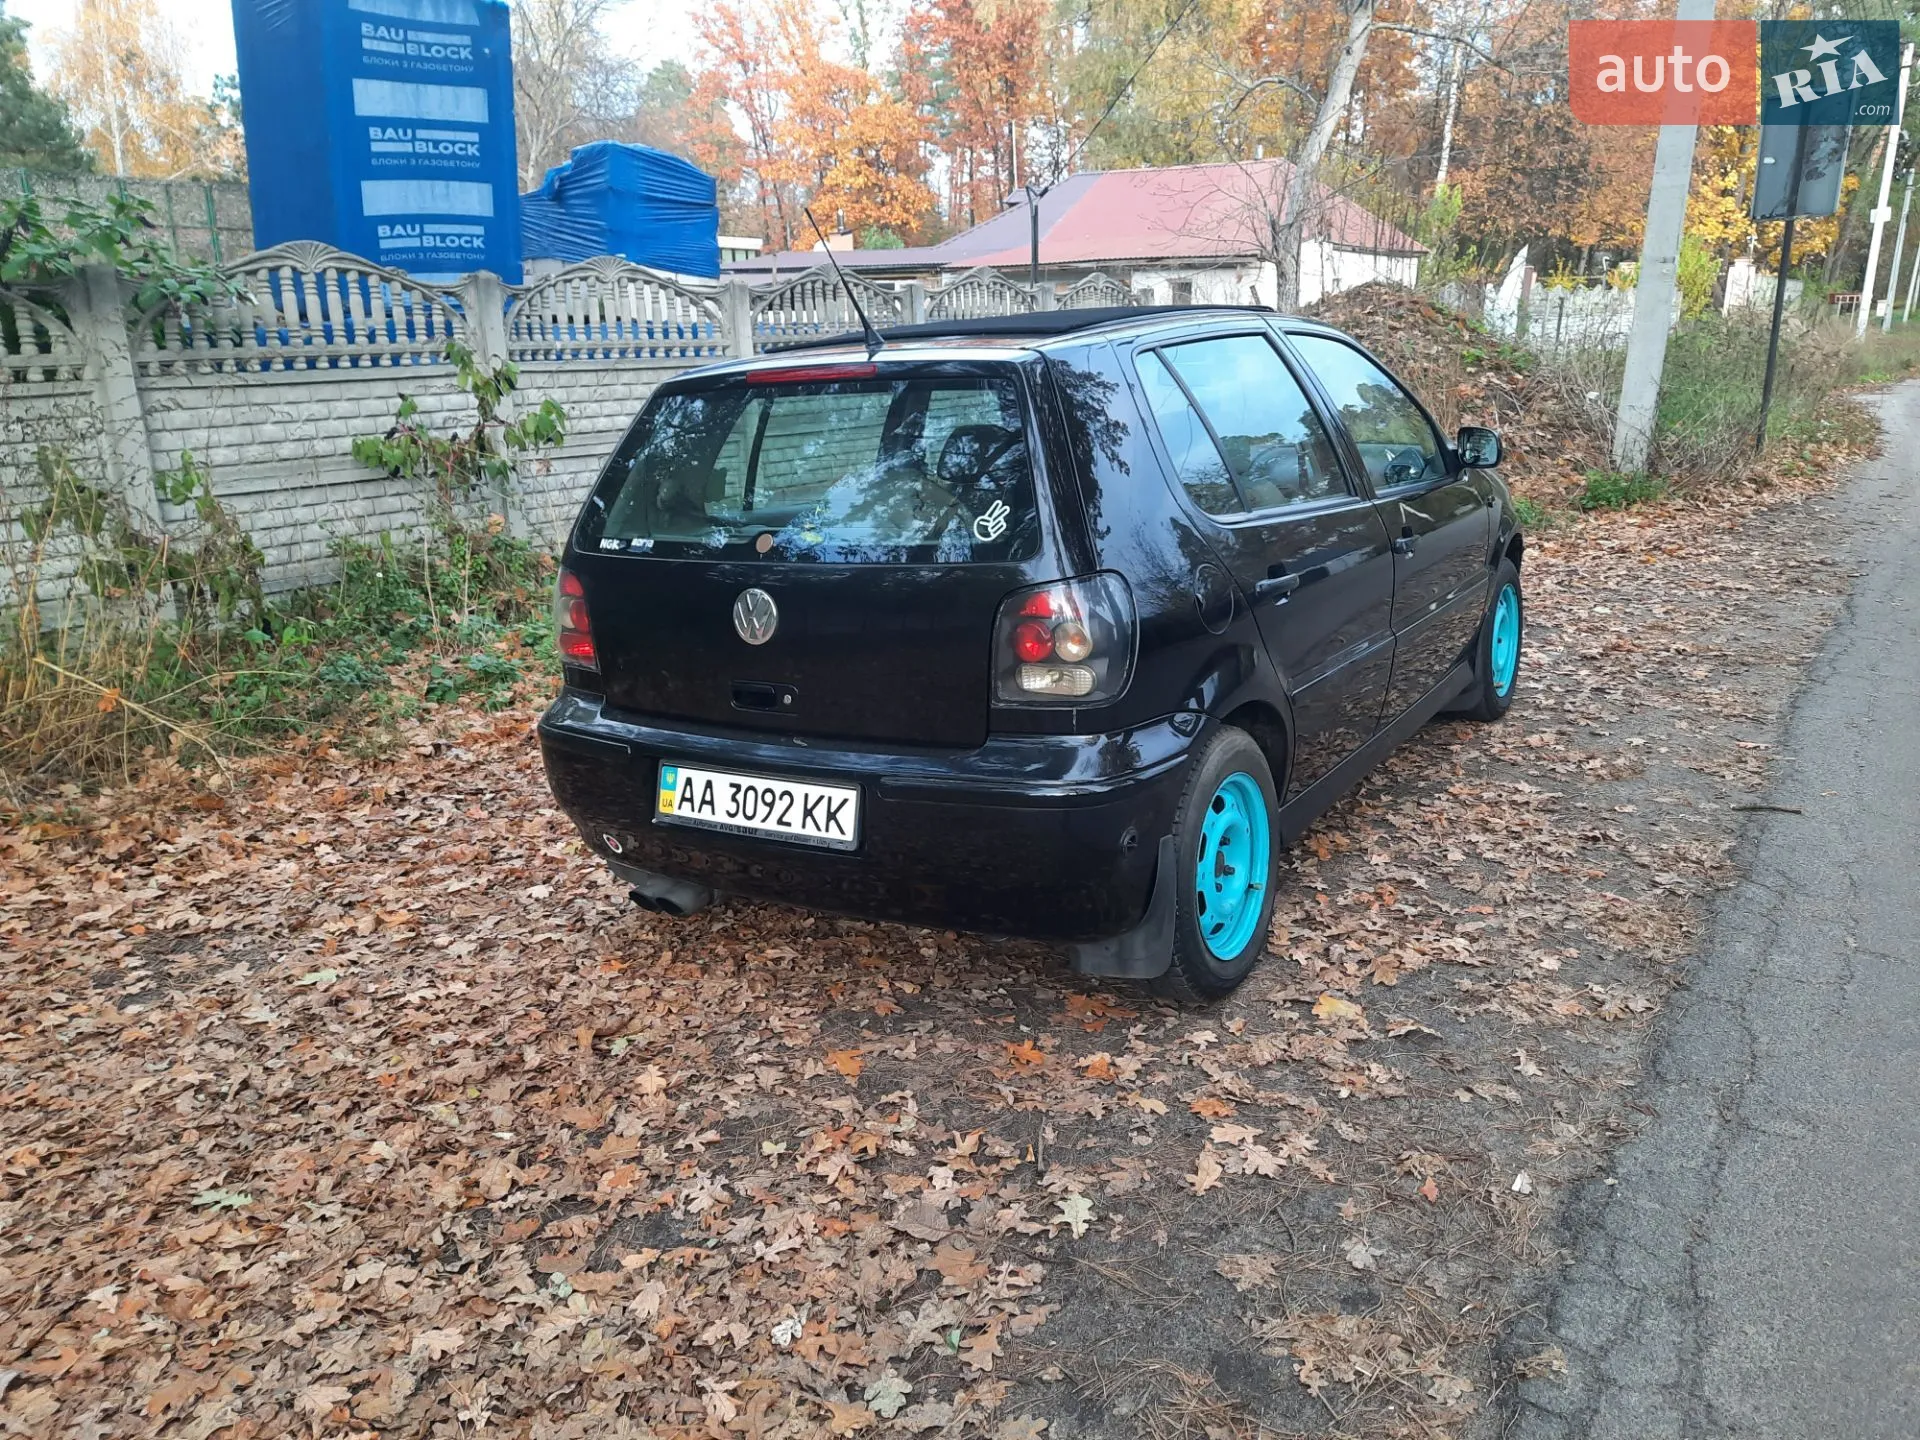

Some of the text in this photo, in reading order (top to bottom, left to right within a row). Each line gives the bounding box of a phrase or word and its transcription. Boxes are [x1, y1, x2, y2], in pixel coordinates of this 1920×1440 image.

[361, 22, 404, 41] BAU
[406, 42, 473, 60] BLOCK
[362, 56, 399, 67] БЛОКИ
[411, 61, 474, 73] ГАЗОБЕТОНУ
[369, 127, 412, 140] BAU
[415, 141, 480, 156] BLOCK
[371, 158, 407, 166] БЛОКИ
[418, 159, 480, 168] ГАЗОБЕТОНУ
[377, 224, 420, 237] BAU
[422, 235, 485, 248] BLOCK
[662, 798, 673, 808] UA
[678, 777, 849, 836] AA 3092 KK
